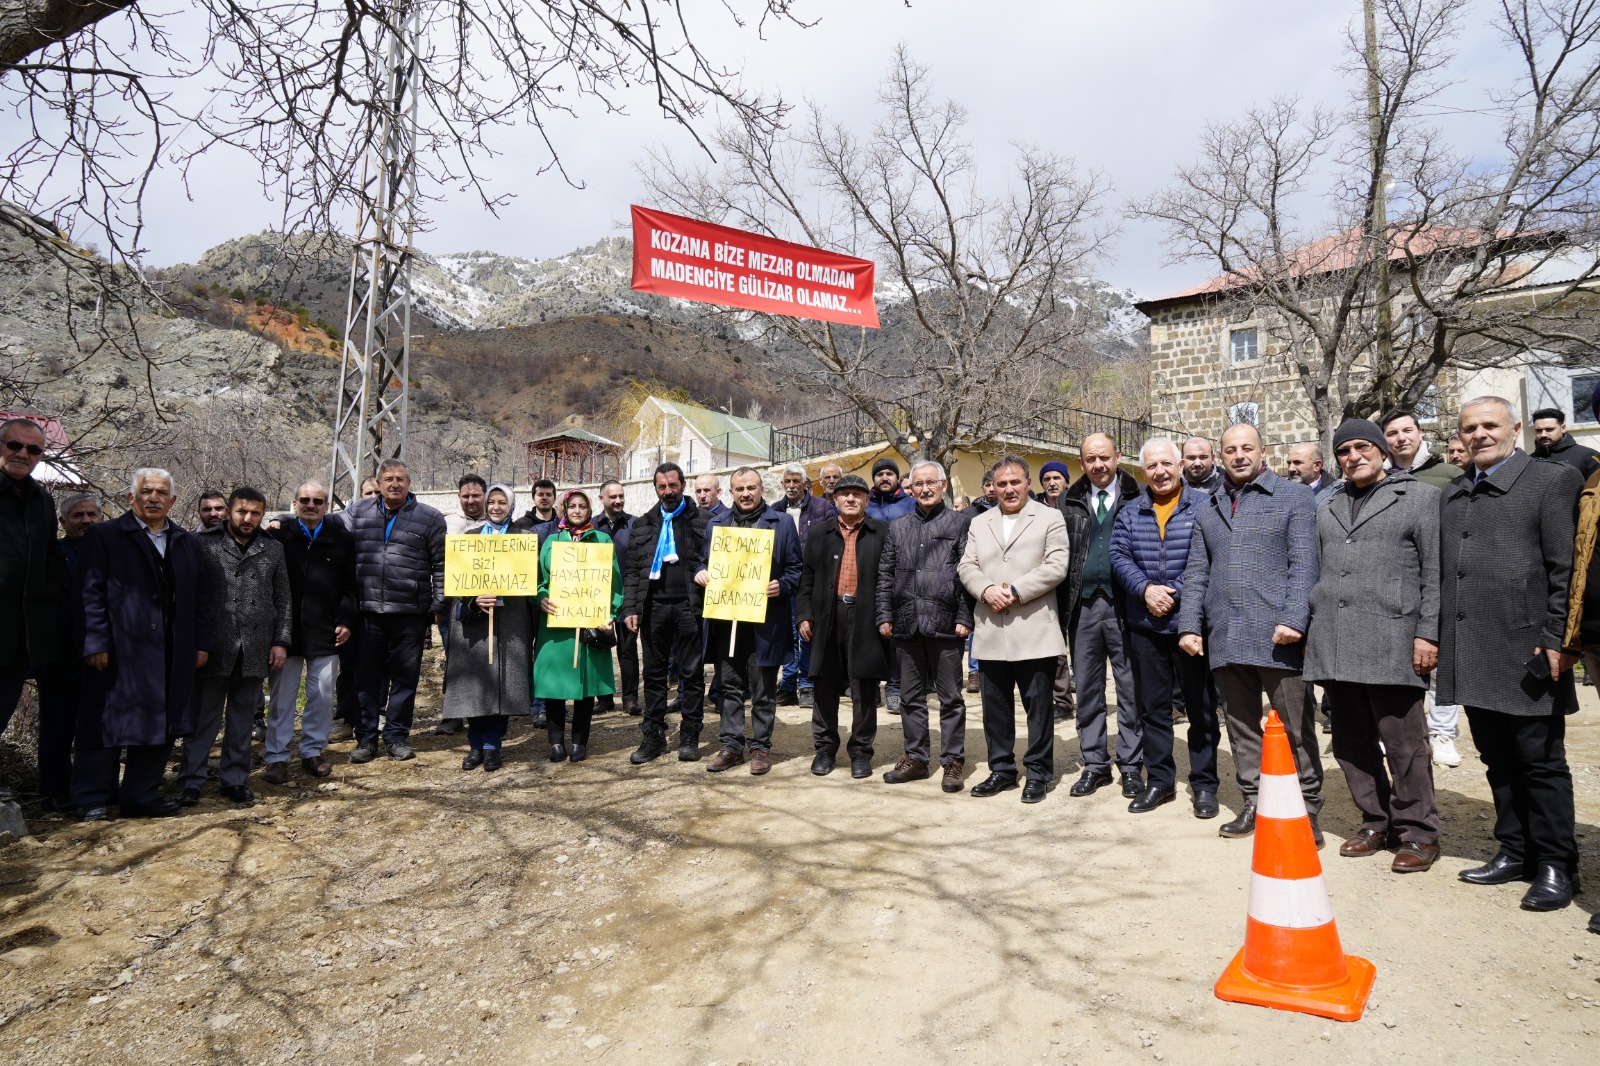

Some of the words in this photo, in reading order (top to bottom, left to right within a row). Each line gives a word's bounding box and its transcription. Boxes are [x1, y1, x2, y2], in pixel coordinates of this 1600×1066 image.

[651, 228, 710, 260] KOZANA
[714, 241, 745, 267] BİZE
[748, 251, 793, 277] MEZAR
[796, 262, 855, 290] OLMADAN
[651, 257, 735, 292] MADENCİYE
[738, 274, 793, 303] GÜLİZAR
[562, 546, 588, 563] SU
[736, 536, 771, 555] DAMLA
[551, 568, 611, 583] HAYATTIR
[710, 563, 730, 580] SU
[452, 573, 528, 591] YILDIRAMAZ
[705, 589, 765, 607] BURADAYIZ
